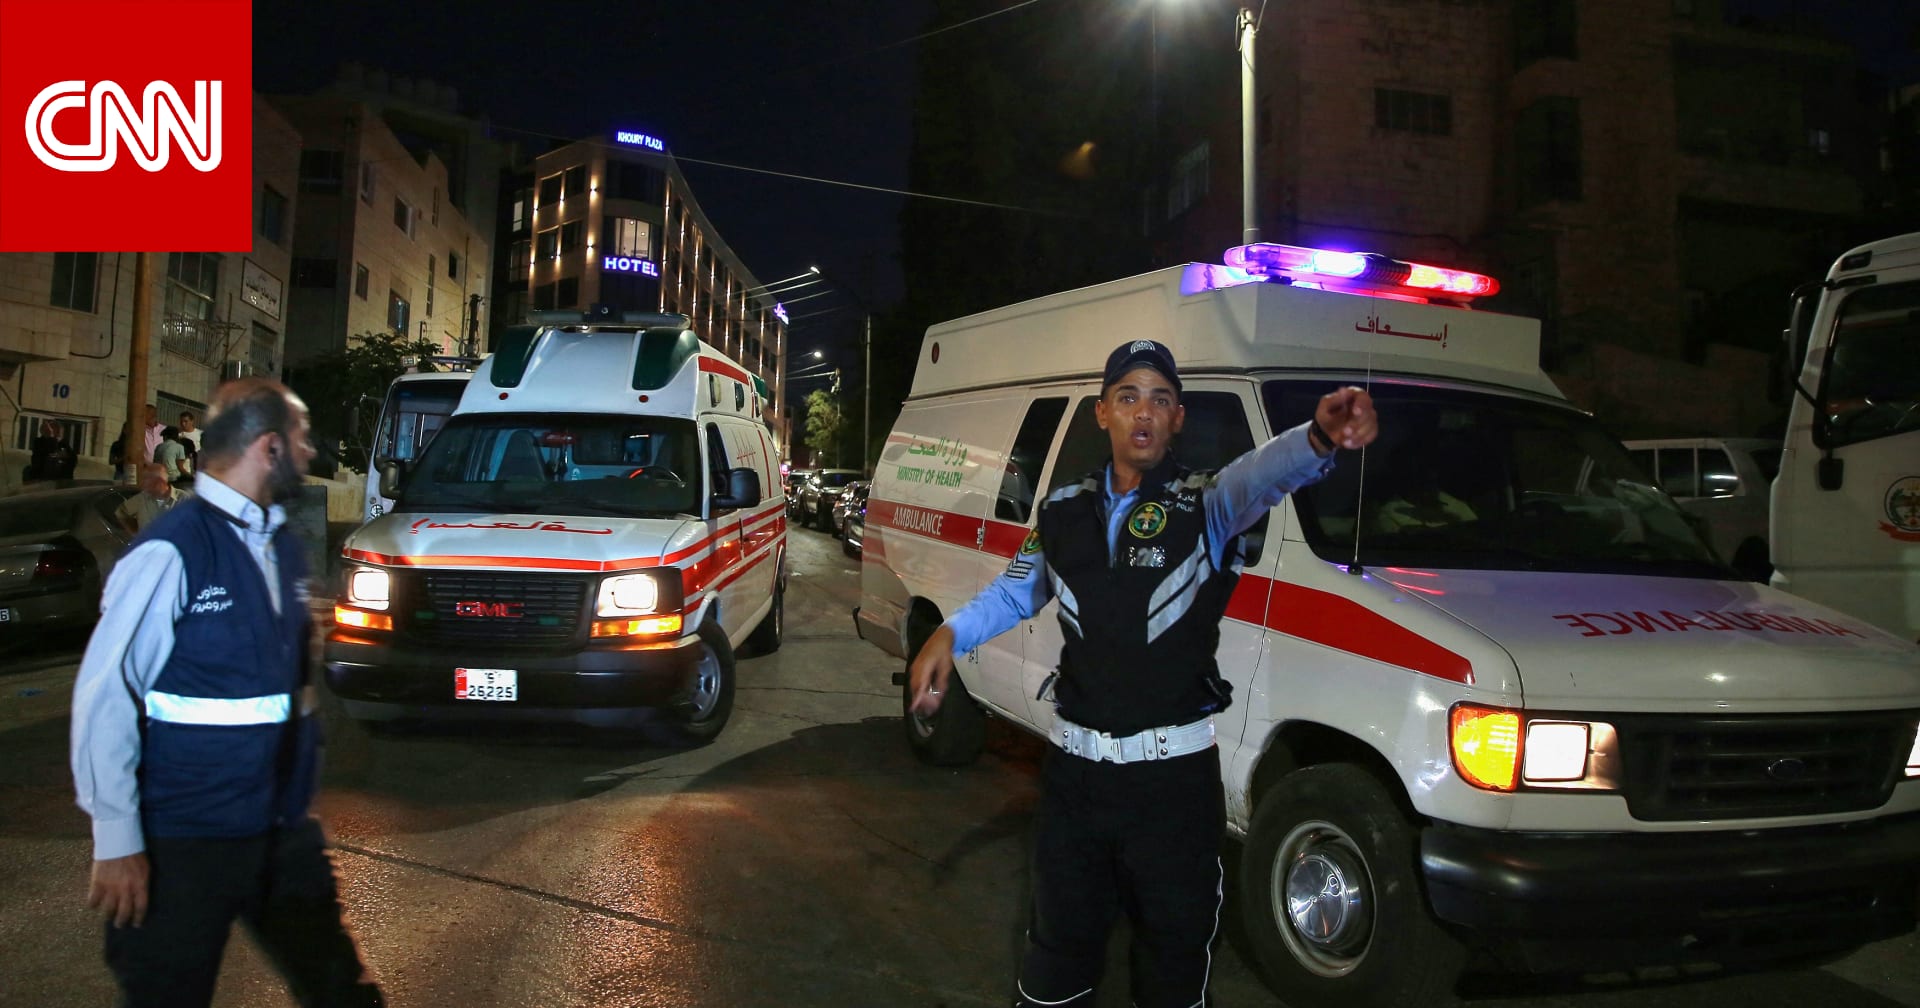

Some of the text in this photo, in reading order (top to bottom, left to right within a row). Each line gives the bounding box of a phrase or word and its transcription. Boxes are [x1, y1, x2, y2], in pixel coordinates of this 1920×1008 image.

[617, 131, 663, 151] KHOURY PLAZA
[604, 257, 659, 277] HOTEL
[52, 383, 70, 399] 10
[908, 434, 968, 466] وزارة الصحة
[897, 466, 964, 488] MINISTRY OF HEALTH
[892, 507, 944, 536] AMBULANCE
[456, 601, 525, 618] GMC
